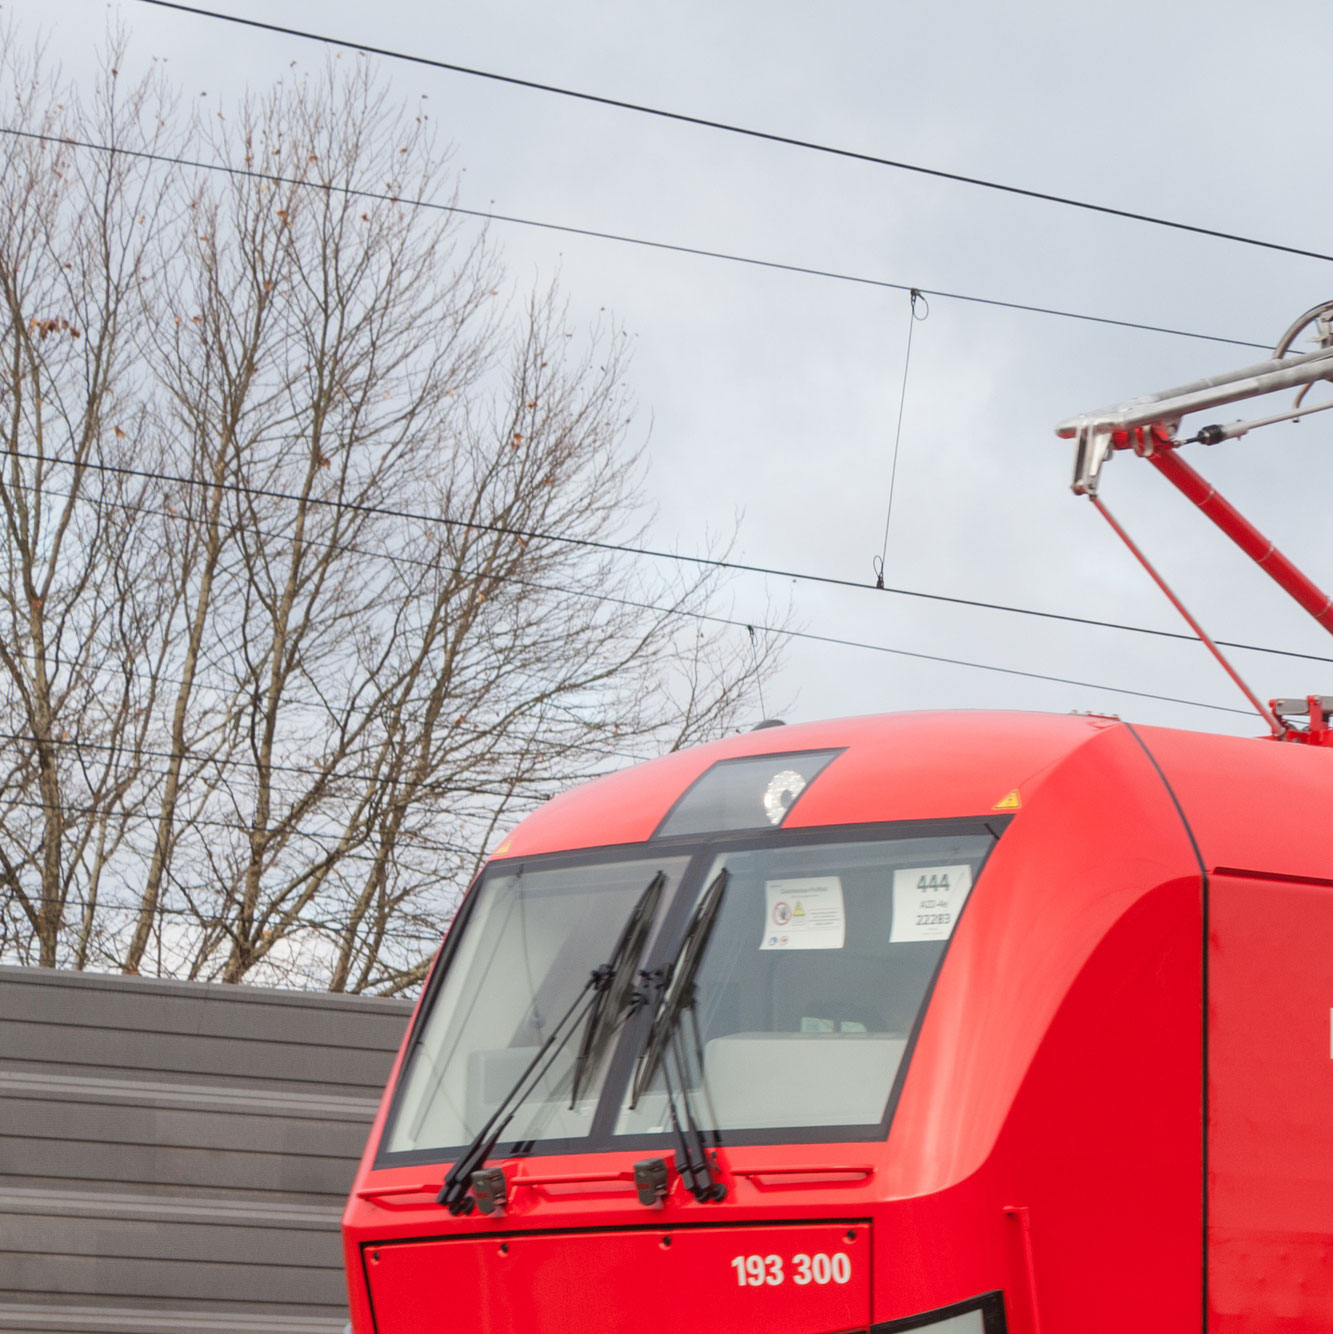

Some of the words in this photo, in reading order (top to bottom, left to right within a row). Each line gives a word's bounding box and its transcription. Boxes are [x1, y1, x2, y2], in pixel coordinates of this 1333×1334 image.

[916, 874, 951, 892] 444
[731, 1254, 784, 1286] 193
[791, 1252, 852, 1285] 300
